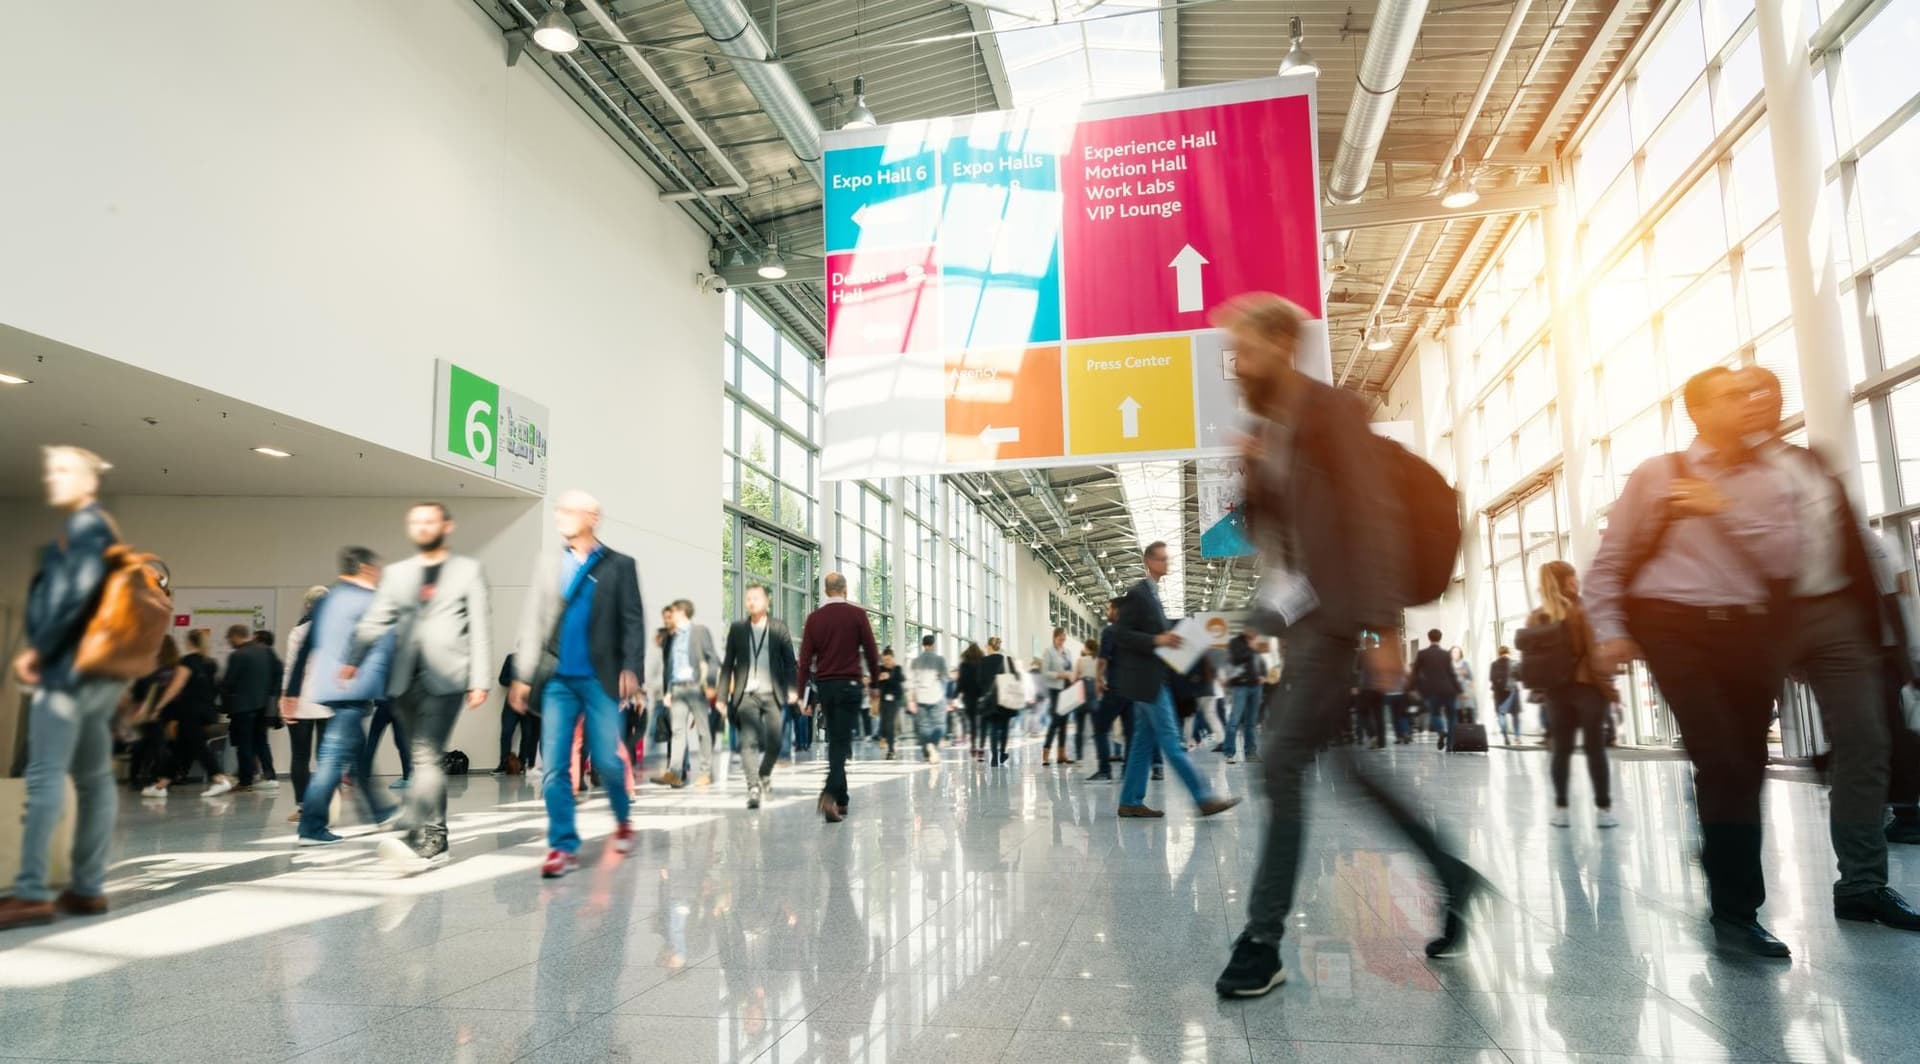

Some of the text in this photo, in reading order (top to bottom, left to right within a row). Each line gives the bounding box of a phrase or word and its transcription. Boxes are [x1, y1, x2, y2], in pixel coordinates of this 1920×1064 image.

[1084, 130, 1217, 162] Experience Hall
[953, 153, 1043, 178] Expo Halls
[1085, 155, 1187, 180] Motion Hall
[832, 166, 928, 191] Expo Hall 6
[1086, 178, 1176, 200] Work Labs
[1086, 200, 1182, 221] VIP Lounge
[832, 288, 864, 304] Hall
[1086, 355, 1172, 371] Press Center
[465, 400, 493, 462] 6
